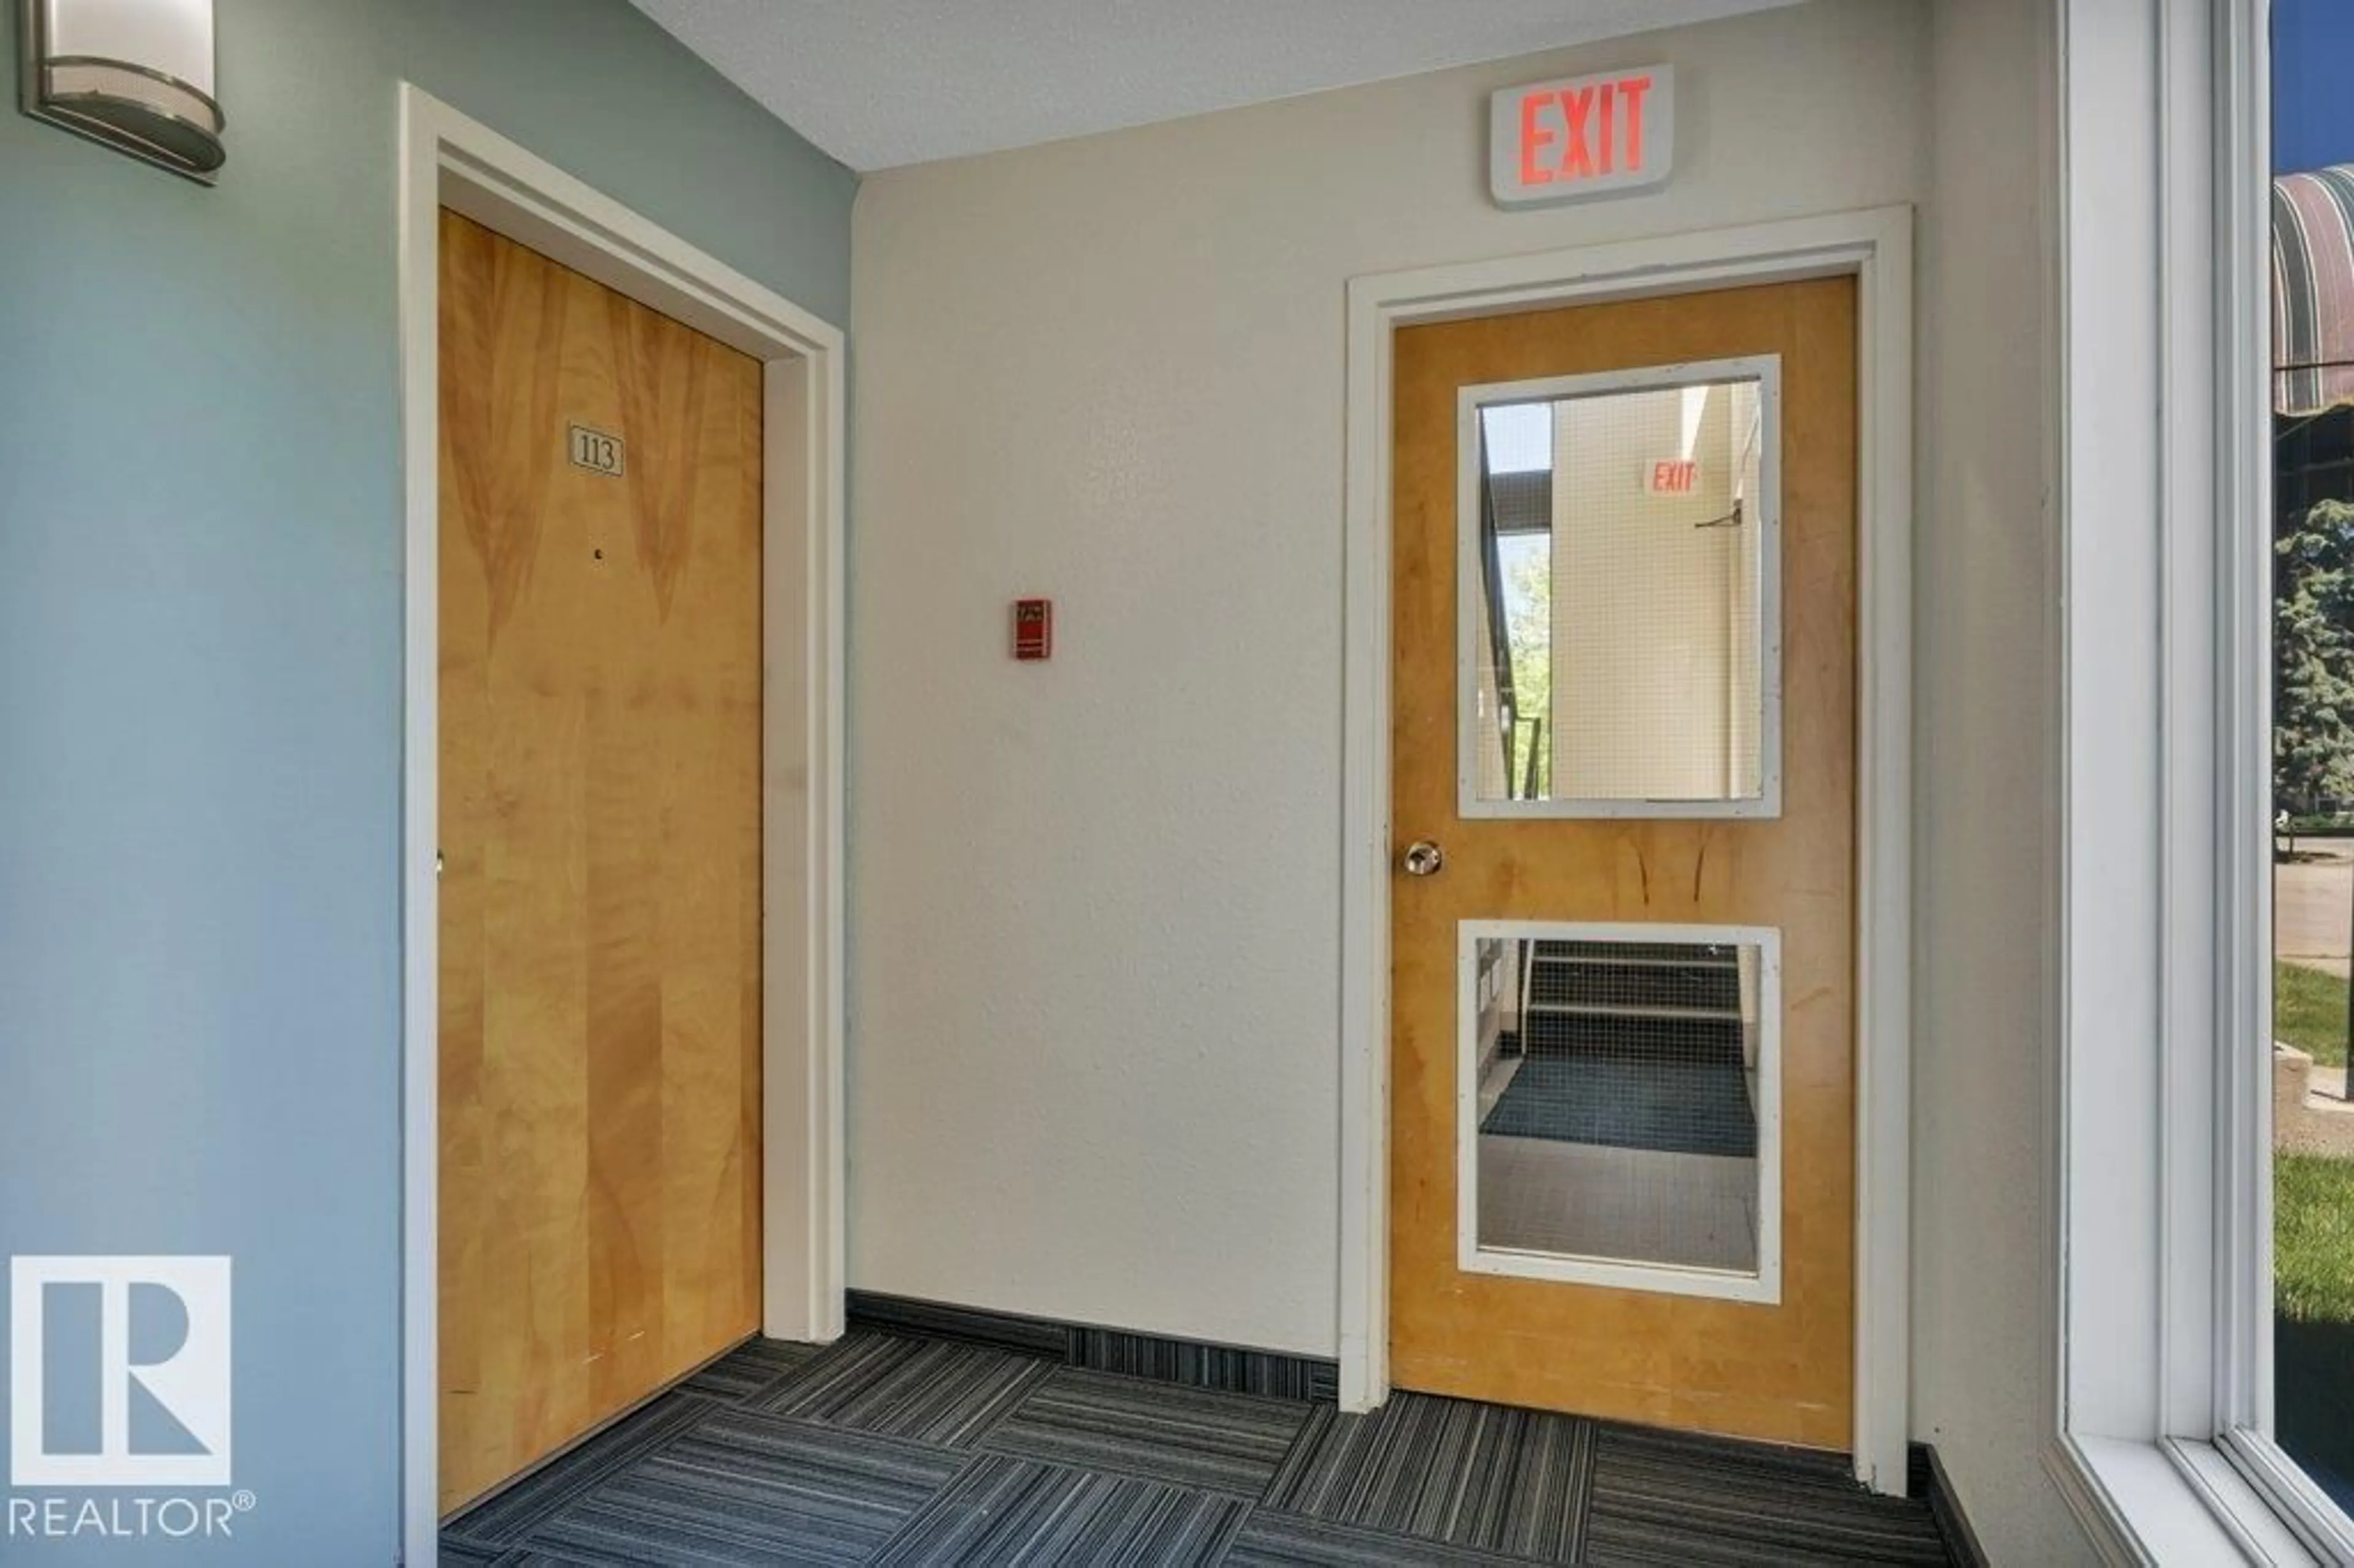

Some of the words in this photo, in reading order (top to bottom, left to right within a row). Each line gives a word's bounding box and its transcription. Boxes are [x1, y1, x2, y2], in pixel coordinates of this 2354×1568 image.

[1521, 76, 1651, 185] EXIT
[582, 435, 615, 470] 113
[1653, 460, 1696, 492] EXIT
